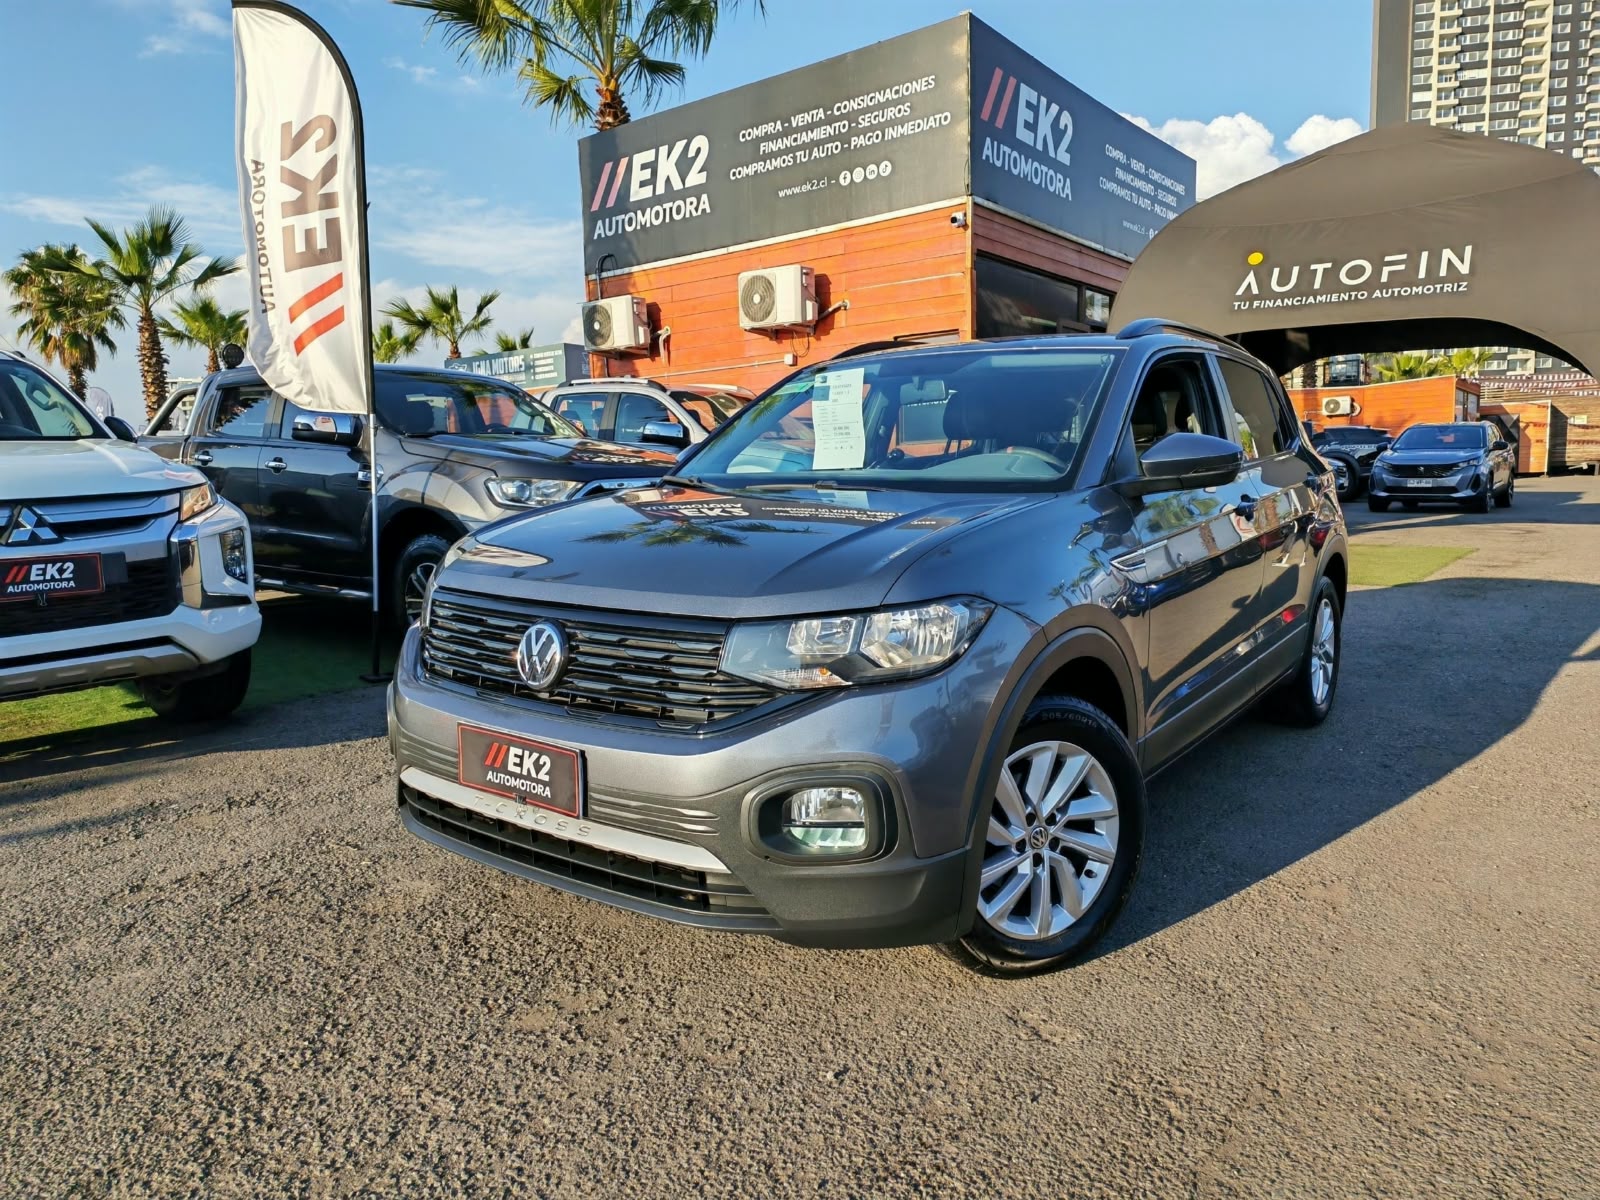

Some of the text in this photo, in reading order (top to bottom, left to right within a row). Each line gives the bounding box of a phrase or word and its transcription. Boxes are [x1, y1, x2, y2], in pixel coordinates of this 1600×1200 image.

[740, 120, 782, 142] COMPRA
[791, 107, 825, 128] VENTA
[833, 75, 936, 116] CONSIGNACIONES
[729, 153, 794, 180] COMPRAMOS
[795, 149, 809, 164] TU
[811, 141, 842, 160] AUTO
[850, 130, 882, 150] PAGO
[884, 111, 951, 141] INMEDIATO
[760, 120, 849, 155] FINANCIAMIENTO
[858, 102, 911, 128] SEGUROS
[778, 176, 828, 198] www.ek2.cl
[982, 136, 1072, 201] AUTOMOTORA
[1105, 143, 1127, 166] COMPRA
[1130, 157, 1145, 175] VENTA
[1148, 168, 1186, 196] CONSIGNACIONES
[1115, 167, 1155, 196] FINANCIAMIENTO
[1157, 189, 1177, 207] SEGUROS
[1099, 176, 1131, 202] COMPRAMOS
[1131, 191, 1138, 205] TU
[1138, 196, 1151, 212] AUTO
[593, 193, 711, 240] AUTOMOTORA
[1235, 244, 1473, 296] AUTOFIN
[1233, 281, 1468, 310] TU FINANCIAMIENTO AUTOMOTRIZ
[491, 354, 525, 376] MOTORS
[7, 580, 76, 593] AUTOMOTORA
[30, 561, 75, 581] EK2
[507, 746, 551, 782] EK2
[486, 770, 552, 799] AUTOMOTORA
